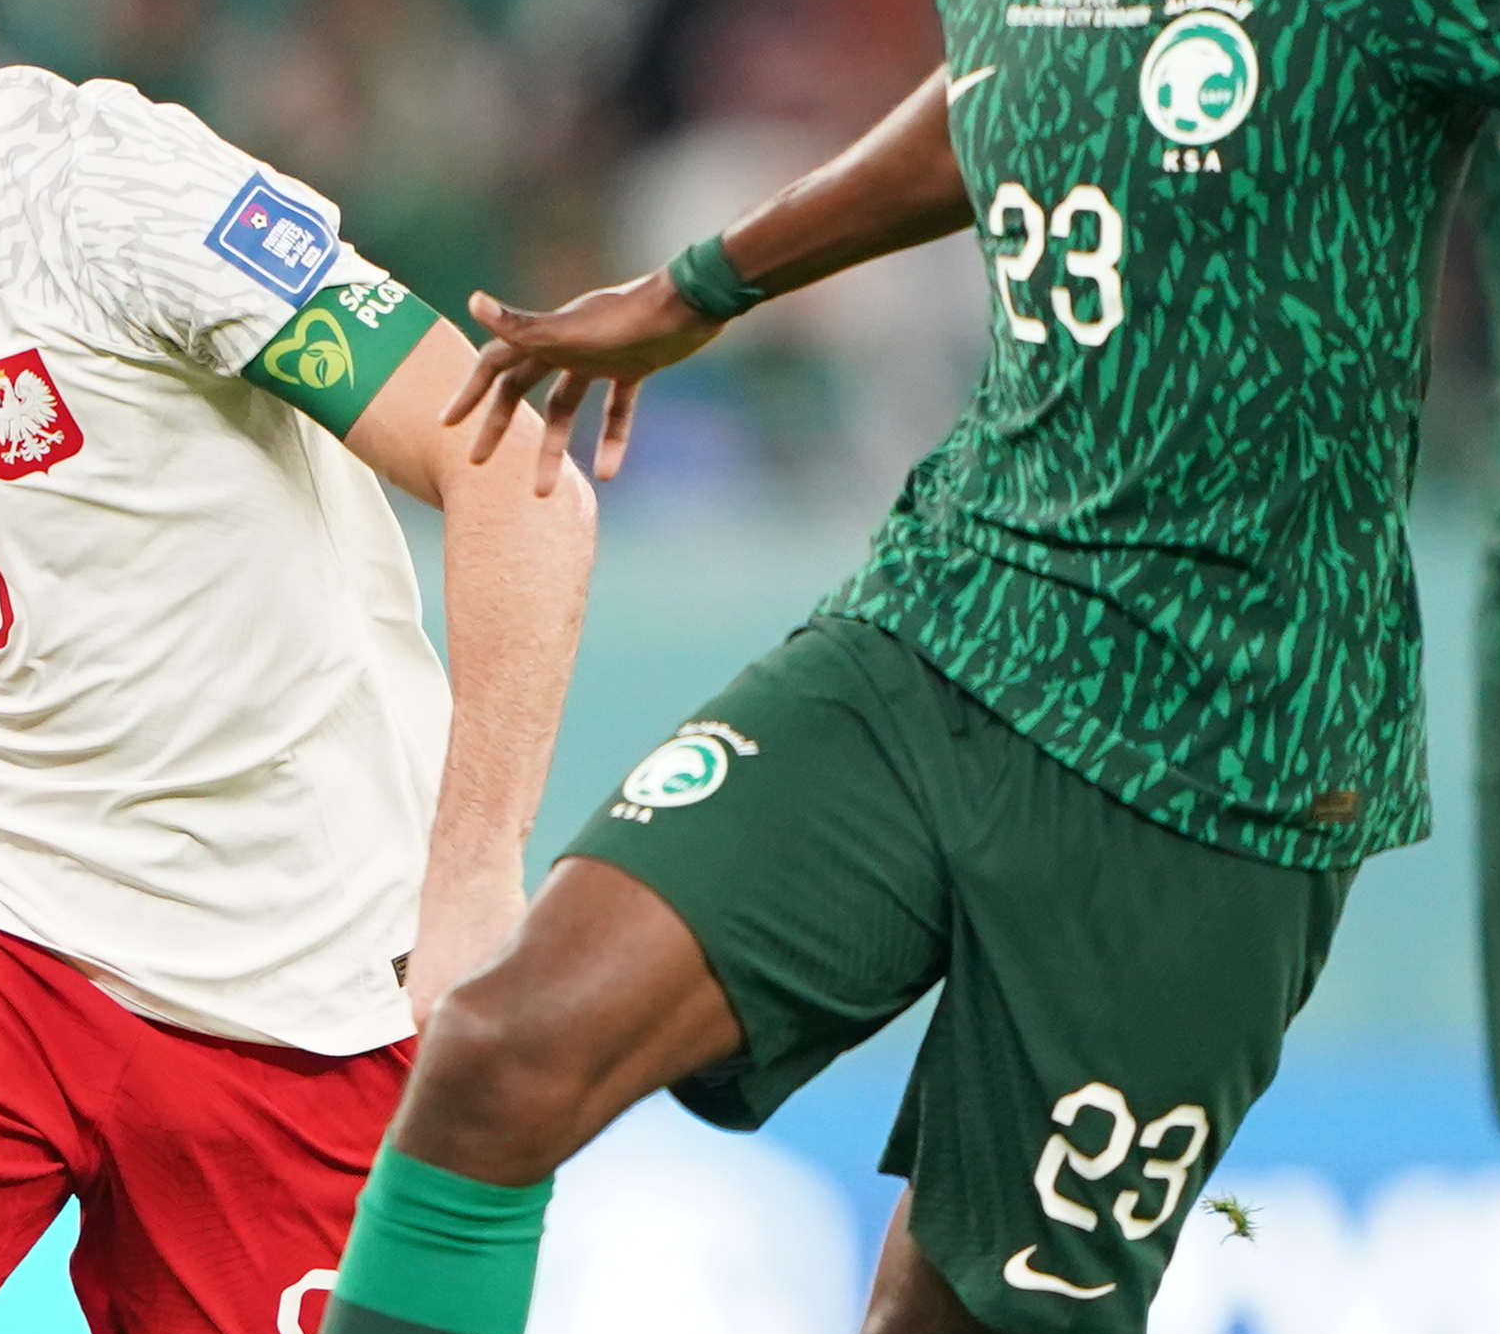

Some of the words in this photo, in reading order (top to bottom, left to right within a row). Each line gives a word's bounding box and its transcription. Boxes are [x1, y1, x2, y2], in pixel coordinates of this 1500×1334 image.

[1162, 148, 1221, 173] KSA
[271, 223, 303, 259] UNITES
[989, 182, 1125, 347] 23
[339, 283, 376, 312] SA
[1034, 1082, 1209, 1240] 23
